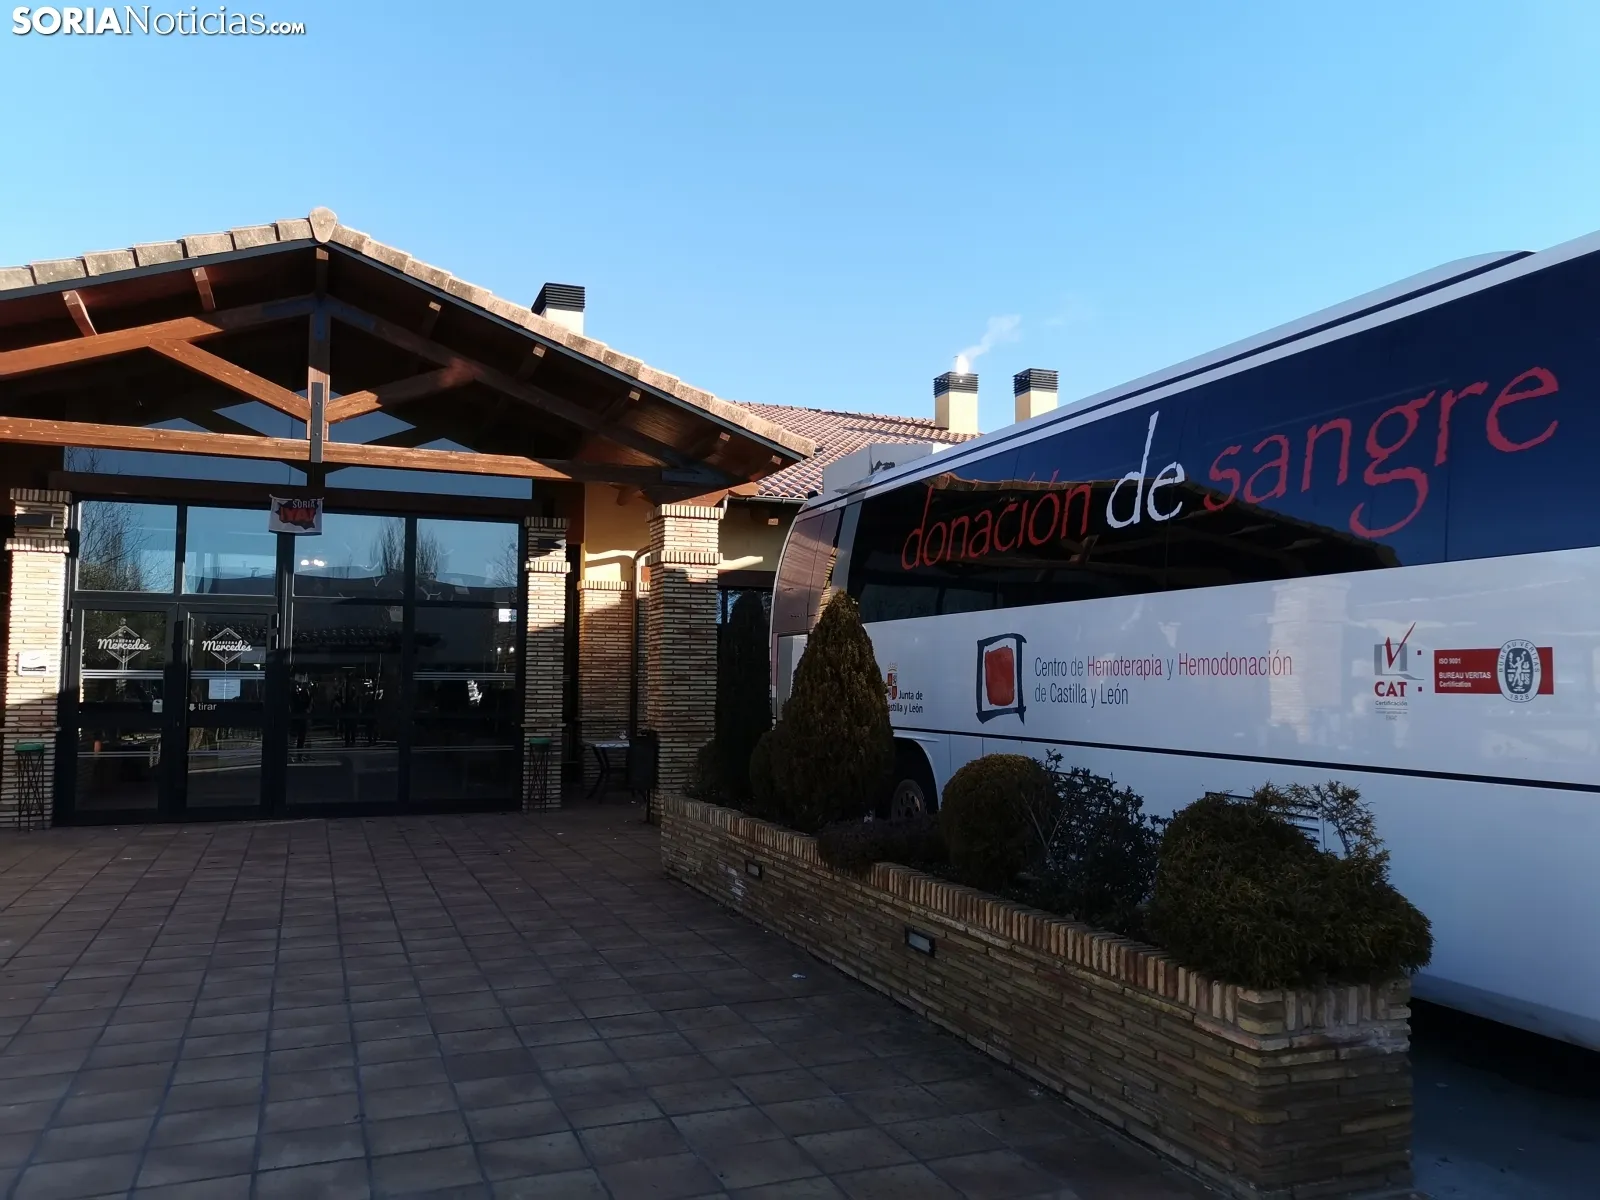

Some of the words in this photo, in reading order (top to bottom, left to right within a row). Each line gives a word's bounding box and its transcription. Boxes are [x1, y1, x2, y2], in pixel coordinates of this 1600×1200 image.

[901, 469, 1092, 571] donación
[1106, 410, 1185, 529] de
[1204, 366, 1560, 539] sangre
[292, 500, 316, 509] SORIA
[97, 638, 152, 651] Mercedes
[201, 639, 253, 652] Mercedes
[1034, 656, 1067, 677] Centro
[1070, 655, 1084, 677] de
[1087, 653, 1163, 680] Hemoterapia
[1166, 660, 1174, 681] y
[1178, 649, 1292, 676] Hemodonación
[1438, 671, 1464, 679] BUREAU
[1465, 671, 1492, 679] VERITAS
[898, 690, 915, 700] Junta
[915, 690, 923, 701] de
[1034, 682, 1047, 703] de
[1050, 682, 1087, 704] Castilla
[1090, 689, 1097, 709] y
[1100, 682, 1129, 705] León
[1374, 681, 1407, 698] CAT
[198, 702, 218, 711] tirar
[888, 703, 903, 712] astilla
[903, 704, 908, 716] y
[909, 703, 924, 714] León
